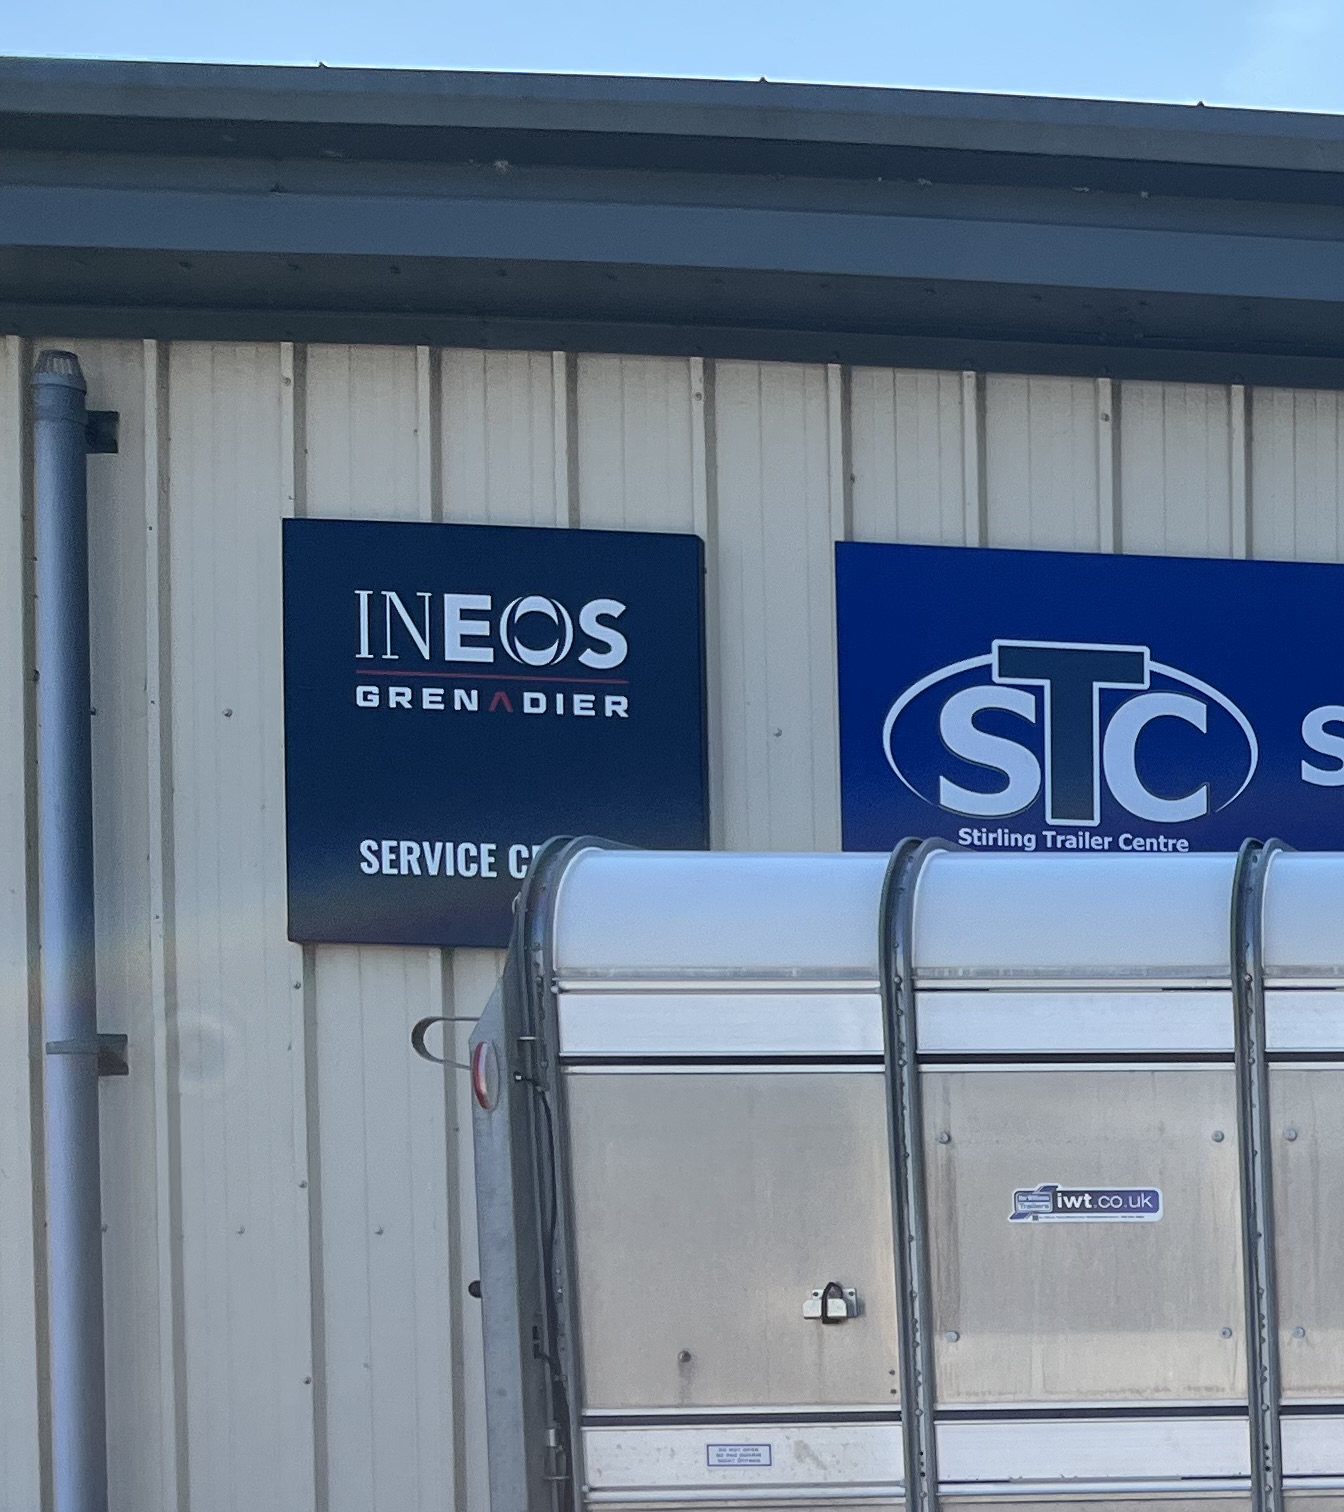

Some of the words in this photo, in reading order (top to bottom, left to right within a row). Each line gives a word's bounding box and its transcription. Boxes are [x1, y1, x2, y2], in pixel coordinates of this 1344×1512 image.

[354, 589, 629, 670] INEOS
[355, 685, 630, 718] GRENADIER
[938, 638, 1209, 827] STC
[957, 827, 1037, 851] Stirling
[1042, 830, 1113, 850] Trailer
[1117, 833, 1190, 852] Centre
[359, 838, 498, 879] SERVICE
[508, 843, 542, 880] C
[1057, 1192, 1154, 1210] iwt.co.uk
